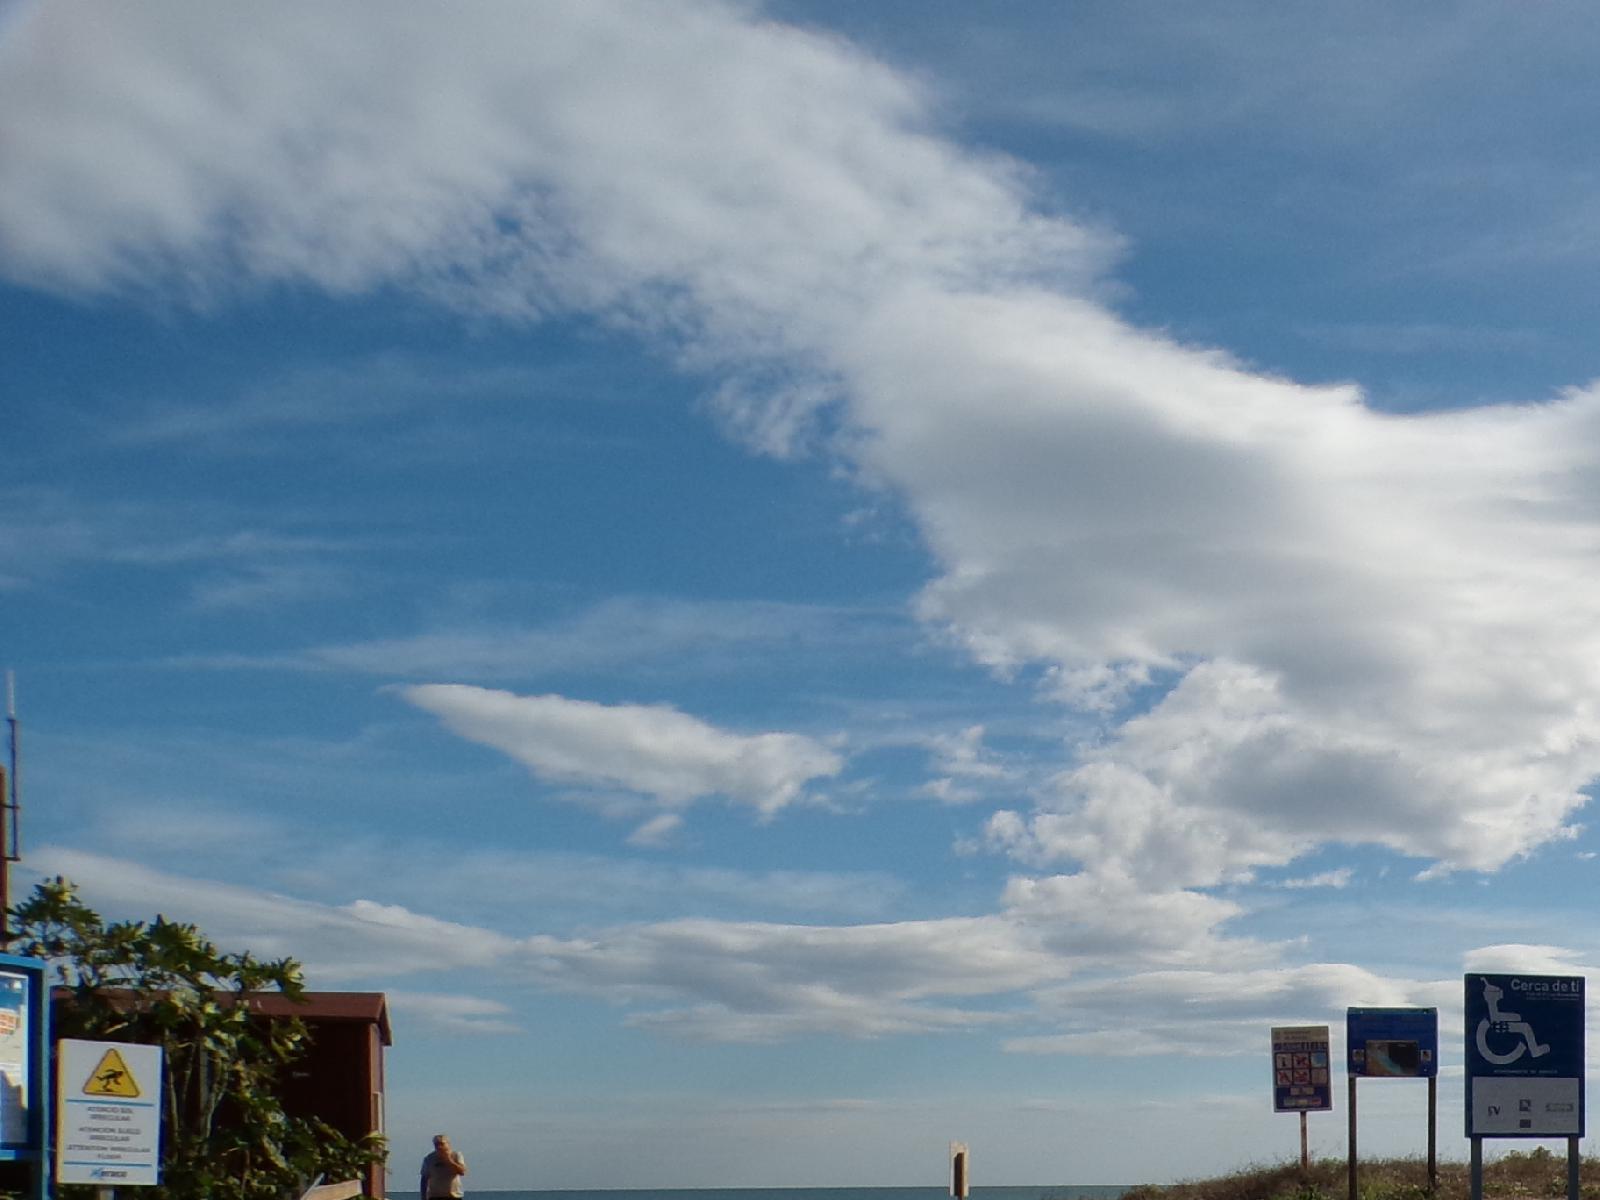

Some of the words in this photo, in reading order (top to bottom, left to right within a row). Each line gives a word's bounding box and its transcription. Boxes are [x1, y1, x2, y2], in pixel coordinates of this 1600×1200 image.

[1511, 979, 1549, 991] Cerca
[1552, 980, 1568, 992] de
[1571, 980, 1580, 992] ti
